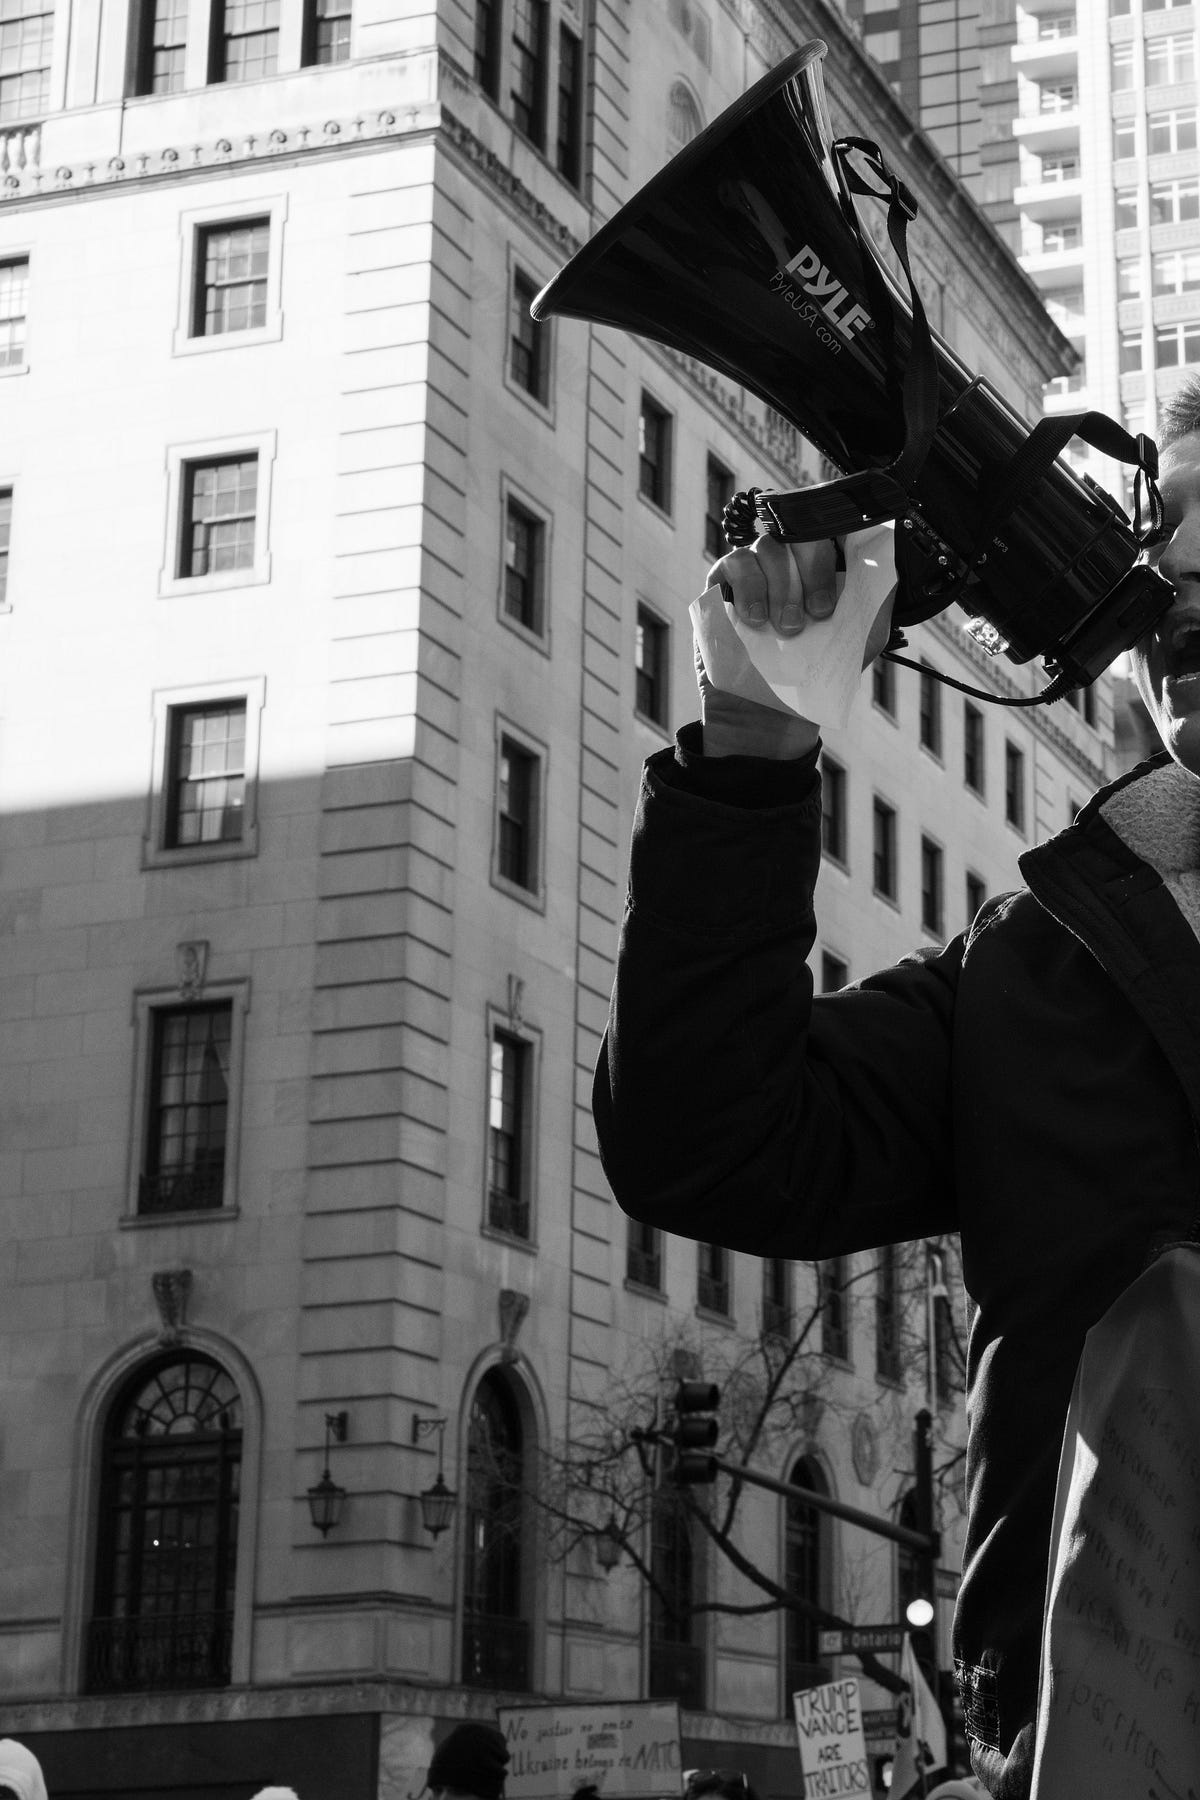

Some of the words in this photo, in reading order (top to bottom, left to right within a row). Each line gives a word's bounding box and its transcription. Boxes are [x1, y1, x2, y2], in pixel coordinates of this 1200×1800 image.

[992, 536, 1009, 553] MP3
[851, 1631, 901, 1649] Ontario
[797, 1682, 857, 1717] TRUMP
[507, 1716, 529, 1742] No
[798, 1712, 860, 1739] VANCE
[510, 1750, 568, 1777] Ukraine
[633, 1740, 681, 1770] NATO
[817, 1743, 843, 1763] ARE
[804, 1760, 869, 1798] TRAITORS
